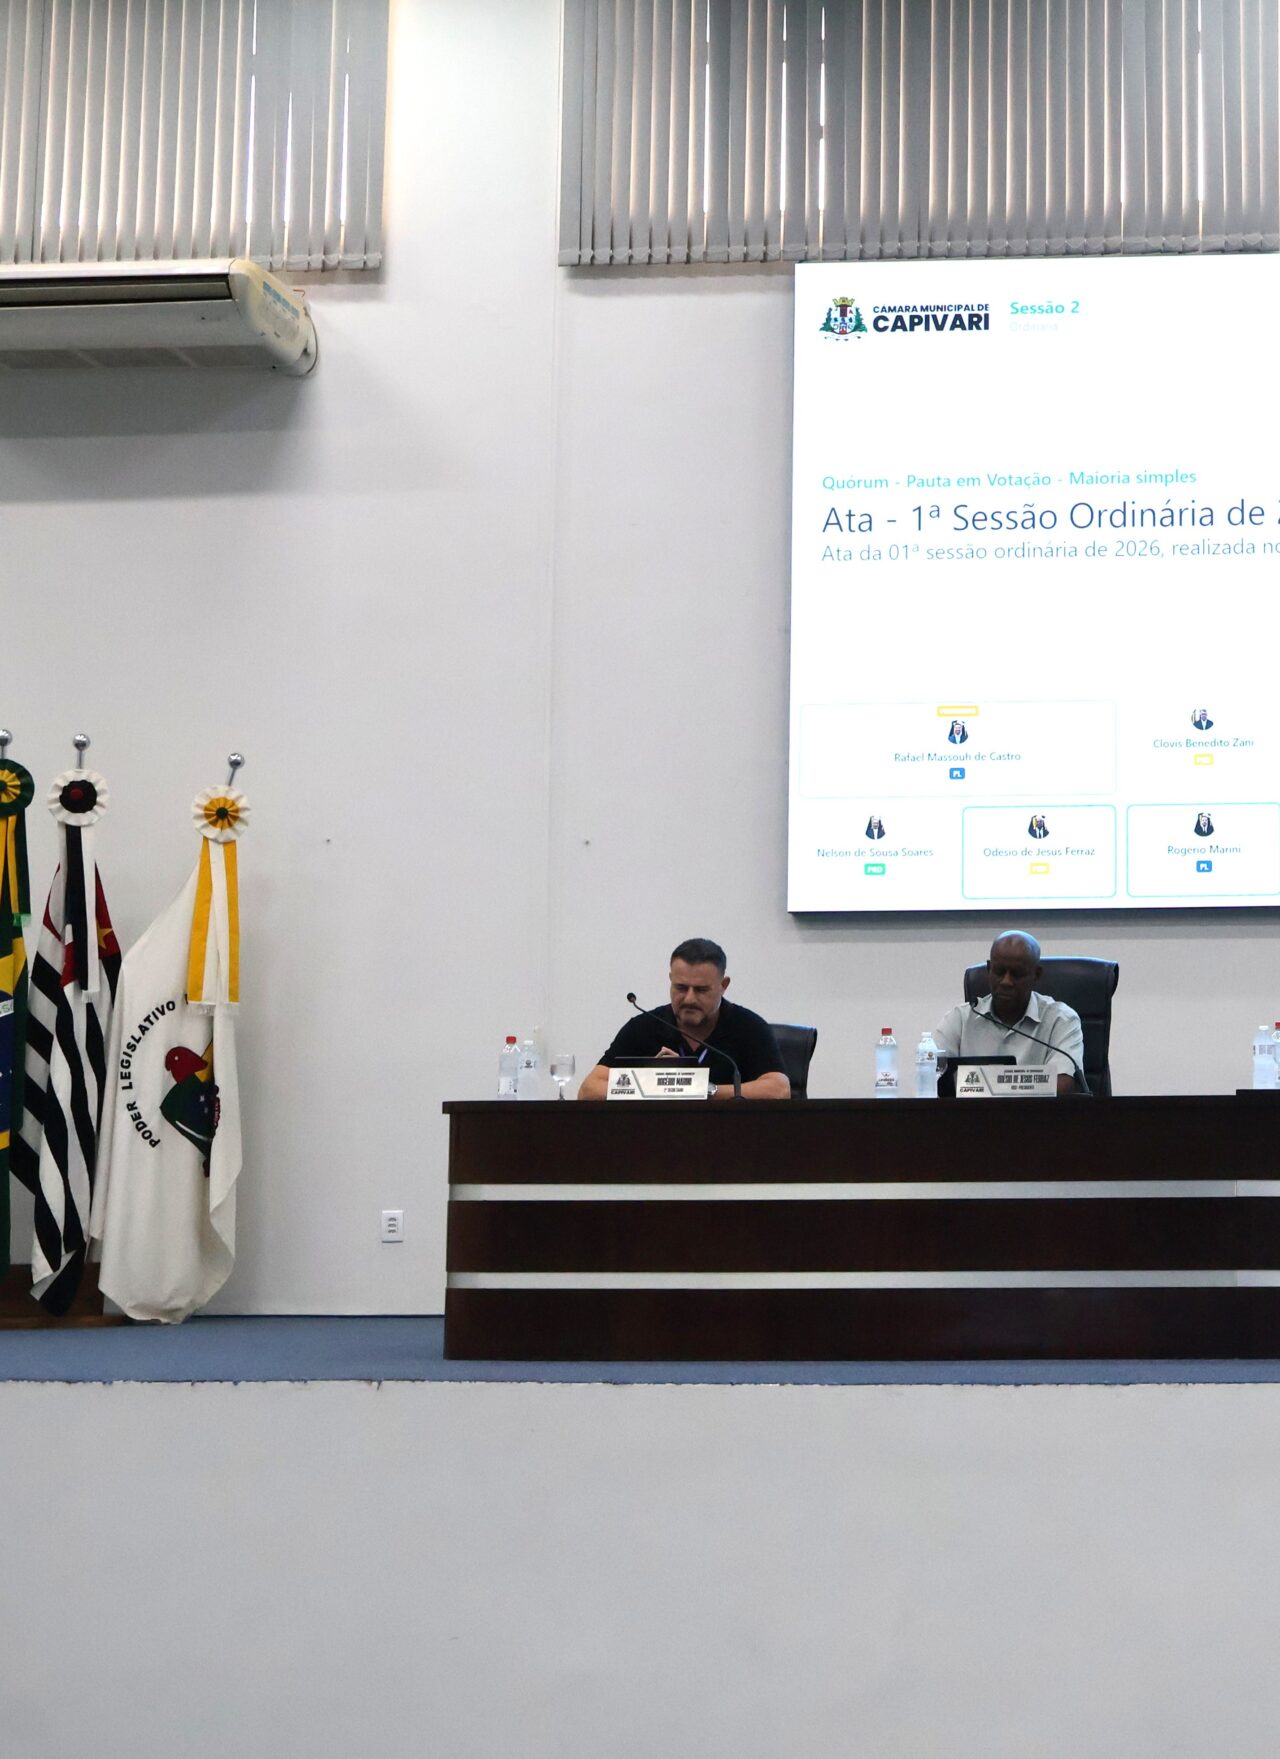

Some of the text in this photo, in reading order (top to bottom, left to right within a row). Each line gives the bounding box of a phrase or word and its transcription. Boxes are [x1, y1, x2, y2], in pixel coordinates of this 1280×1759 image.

[920, 304, 975, 312] MUNICIPAL
[1010, 301, 1079, 314] Sessão 2
[873, 313, 989, 332] CAPIVARI
[823, 477, 888, 490] Quórum
[908, 475, 951, 487] Pauta
[957, 477, 980, 486] em
[988, 474, 1051, 488] Votação
[1070, 471, 1130, 484] Maioria
[1137, 469, 1196, 486] simples
[823, 507, 872, 532] Ata
[913, 505, 940, 531] 1ª
[954, 504, 1057, 531] Sessão
[1070, 499, 1213, 528] Ordinária
[1228, 499, 1264, 526] de
[822, 546, 851, 560] Ata
[860, 545, 881, 560] da
[889, 545, 918, 560] 01ª
[925, 541, 988, 560] sessão
[995, 542, 1077, 558] ordinária
[1085, 541, 1107, 556] de
[1114, 538, 1166, 559] 2026,
[1173, 539, 1255, 555] realizada
[1185, 739, 1230, 747] Benedito
[1232, 738, 1254, 747] Zani
[894, 752, 1022, 762] Rafael Massouh de Castro
[816, 849, 851, 857] Nelson
[869, 848, 899, 856] Sousa
[901, 848, 934, 856] Soares
[1020, 848, 1033, 856] de
[1036, 848, 1063, 856] Jesus
[1065, 847, 1096, 855] Ferraz
[1209, 845, 1241, 853] Marini
[120, 1001, 176, 1148] PODER LEGISLATIVO
